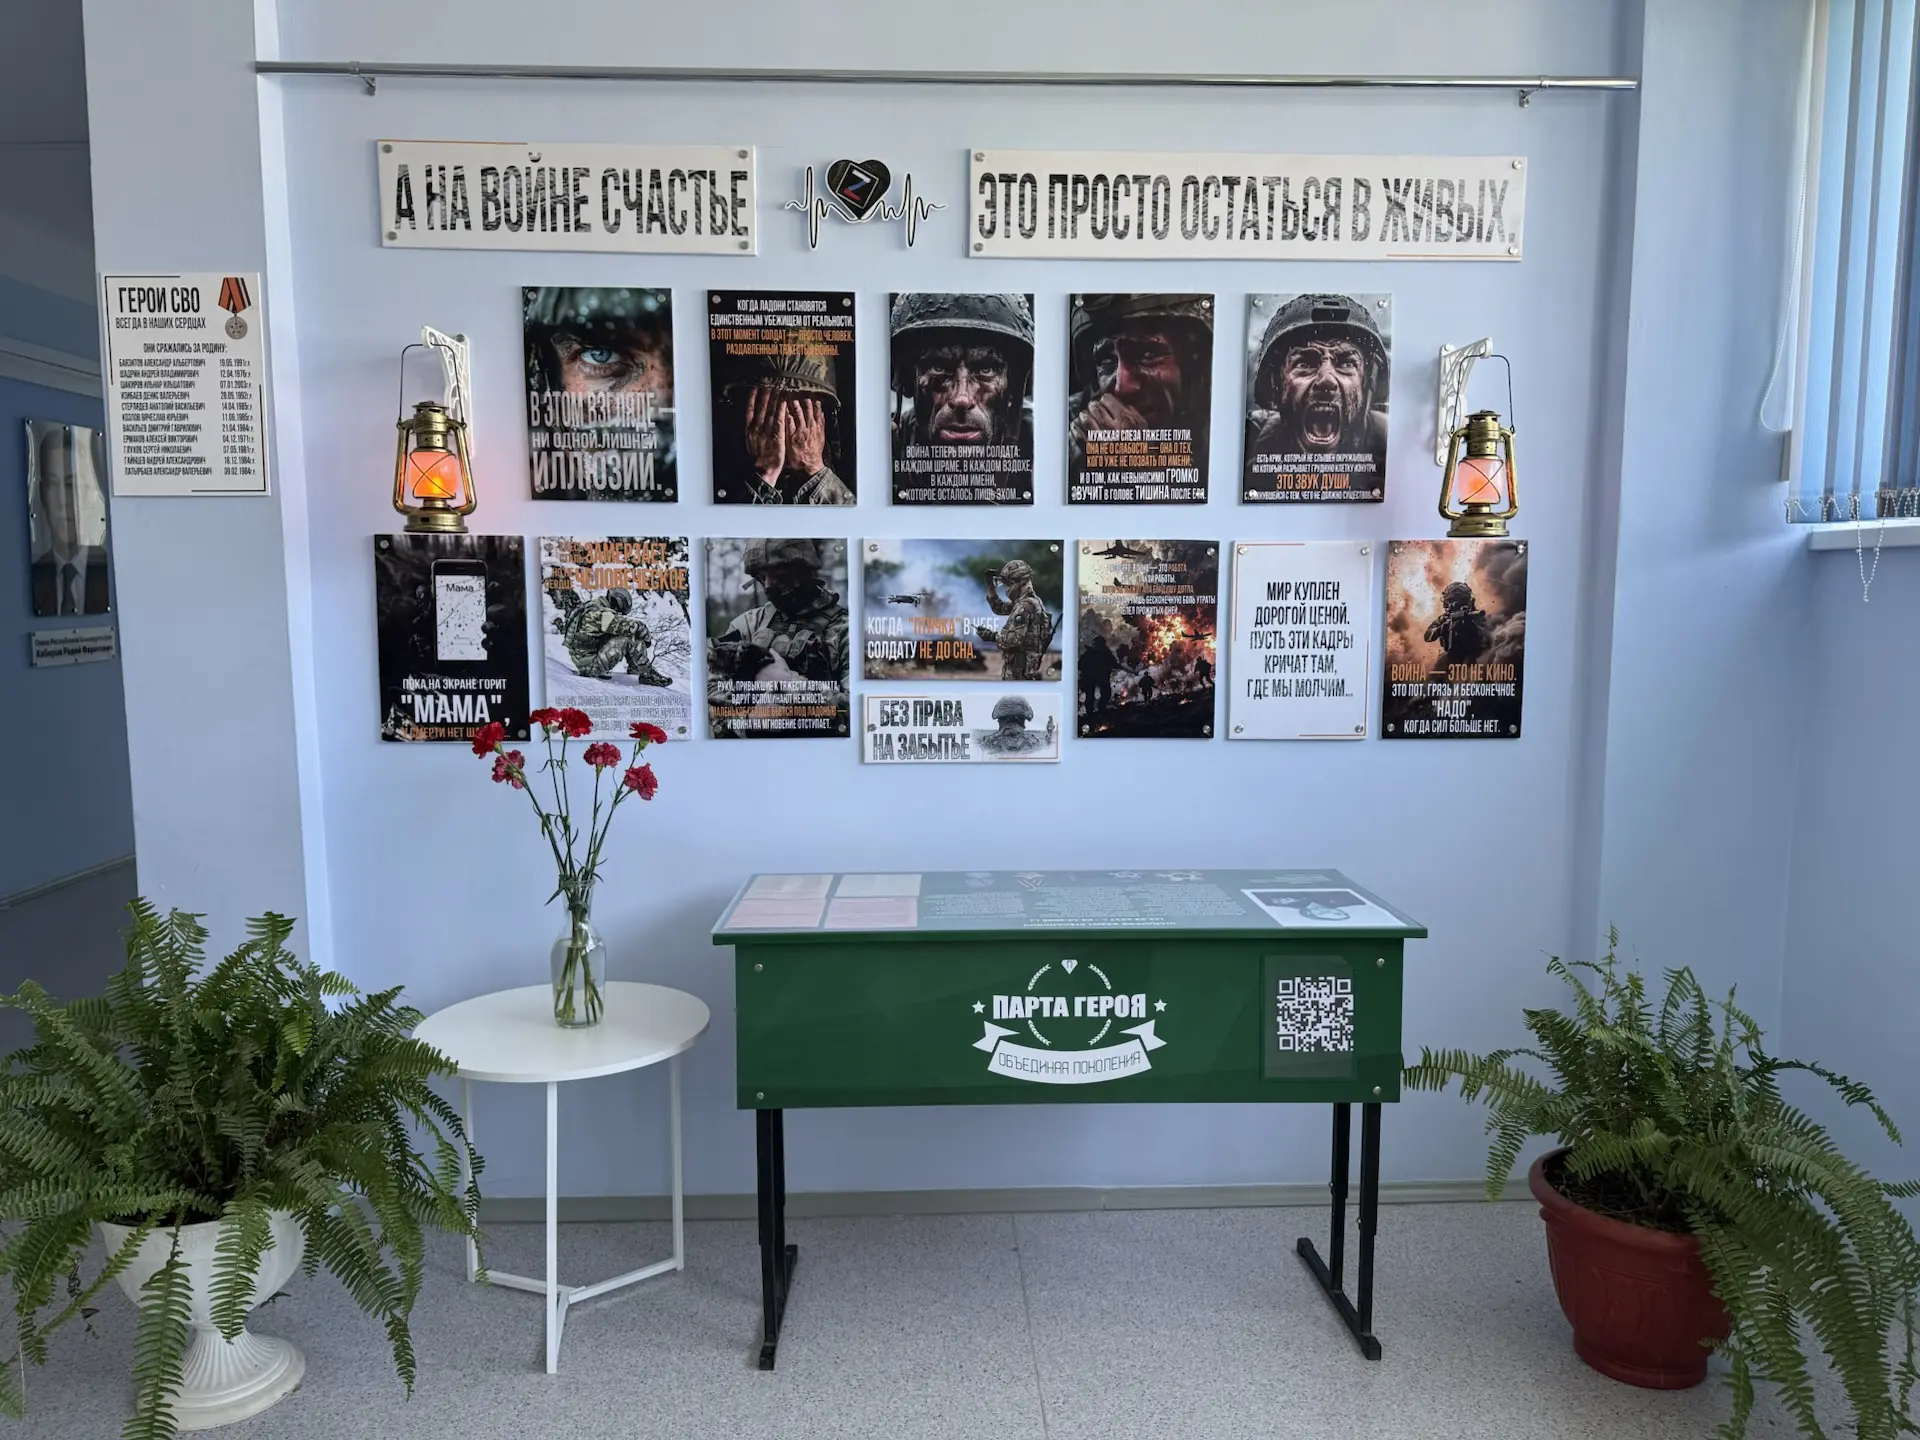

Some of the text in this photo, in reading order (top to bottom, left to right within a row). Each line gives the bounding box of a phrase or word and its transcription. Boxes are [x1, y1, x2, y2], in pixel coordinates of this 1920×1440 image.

[395, 152, 748, 235] А НА ВОЙНЕ СЧАСТЬЕ
[978, 173, 1515, 244] ЭТО ПРОСТО ОСТАТЬСЯ В ЖИВЫХ.
[119, 287, 199, 313] ГЕРОИ СВО
[738, 300, 826, 312] КОГДА ЛАДОНИ СТАНОВЯТСЯ
[116, 318, 206, 329] ВСЕГДА В НАШИХ СЕРДЦАХ
[711, 314, 853, 327] ЕДИНСТВЕННЫМ УБЕЖИЩЕМ ОТ РЕАЛЬНОСТИ.
[717, 329, 732, 339] ЭТОТ
[734, 329, 759, 340] МОМЕНТ
[762, 330, 786, 341] СОЛДАТ
[144, 343, 155, 353] ОНИ
[157, 343, 192, 353] СРАЖАЛИСЬ
[193, 343, 200, 353] ЗА
[530, 391, 655, 432] В ЭТОМ ВЗГЛЯДЕ
[533, 429, 657, 449] НИ ОДНОЙ ЛИШНЕЙ
[1088, 429, 1192, 441] МУЖСКАЯ СЛЕЗА ТЯЖЕЛЕЕ ПУЛИ.
[906, 443, 1020, 459] ВОЙНА ТЕПЕРЬ ВНУТРИ СОЛДАТА:
[1086, 443, 1099, 454] ОНА
[1100, 443, 1108, 454] НЕ
[1115, 443, 1148, 454] СЛАБОСТИ
[1160, 443, 1172, 454] ОНА
[533, 451, 662, 490] ИЛЛЮЗИИ.
[895, 460, 1032, 473] В КАЖДОМ ШРАМЕ, В КАЖДОМ ВЗДОХЕ,
[931, 474, 996, 487] В КАЖДОМ ИМЕНИ,
[1080, 473, 1084, 483] И
[1091, 473, 1106, 484] ТОМ,
[1107, 473, 1120, 483] КАК
[1121, 472, 1164, 483] НЕВЫНОСИМО
[1166, 468, 1198, 483] ГРОМКО
[1277, 474, 1293, 489] ЭТО
[1296, 474, 1319, 489] ЗВУК
[906, 489, 936, 500] КОТОРОЕ
[938, 488, 972, 500] ОСТАЛОСЬ
[975, 489, 995, 501] ЛИШЬ
[1072, 486, 1103, 500] ЗВУЧИТ
[1110, 489, 1133, 500] ГОЛОВЕ
[1135, 486, 1169, 500] ТИШИНА
[1171, 488, 1191, 500] ПОСЛЕ
[446, 584, 474, 592] Мама
[1267, 582, 1339, 601] МИР КУПЛЕН
[1255, 602, 1349, 627] ДОРОГОЙ ЦЕНОЙ.
[868, 617, 903, 637] КОГДА
[964, 617, 969, 634] В
[1250, 630, 1353, 651] ПУСТЬ ЭТИ КАДРЫ
[868, 641, 976, 661] СОЛДАТУ НЕ ДО СНА.
[1265, 655, 1337, 675] КРИЧАТ ТАМ,
[1392, 661, 1516, 681] ВОЙНА ЭТО НЕ КИНО.
[403, 679, 507, 690] ПОКА НА ЭКРАНЕ ГОРИТ
[1247, 679, 1269, 699] ГДЕ
[1272, 679, 1291, 697] МЫ
[1392, 683, 1515, 698] ЭТО ПОТ, ГРЯЗЬ И БЕСКОНЕЧНОЕ
[732, 694, 750, 704] ВДРУГ
[880, 700, 963, 727] БЕЗ ПРАВА
[733, 718, 752, 729] ВОЙНА
[754, 720, 760, 729] НА
[762, 719, 796, 729] МГНОВЕНИЕ
[1404, 720, 1500, 734] КОГДА СИЛ БОЛЬШЕ НЕТ.
[448, 727, 464, 737] НЕТ
[873, 733, 970, 760] НА ЗАБЫТЬЕ
[993, 994, 1146, 1019] ПАРТА ГЕРОЯ
[999, 1051, 1140, 1074] ОБЪЕДИНЯЯ ПОКОЛЕНИЯ
